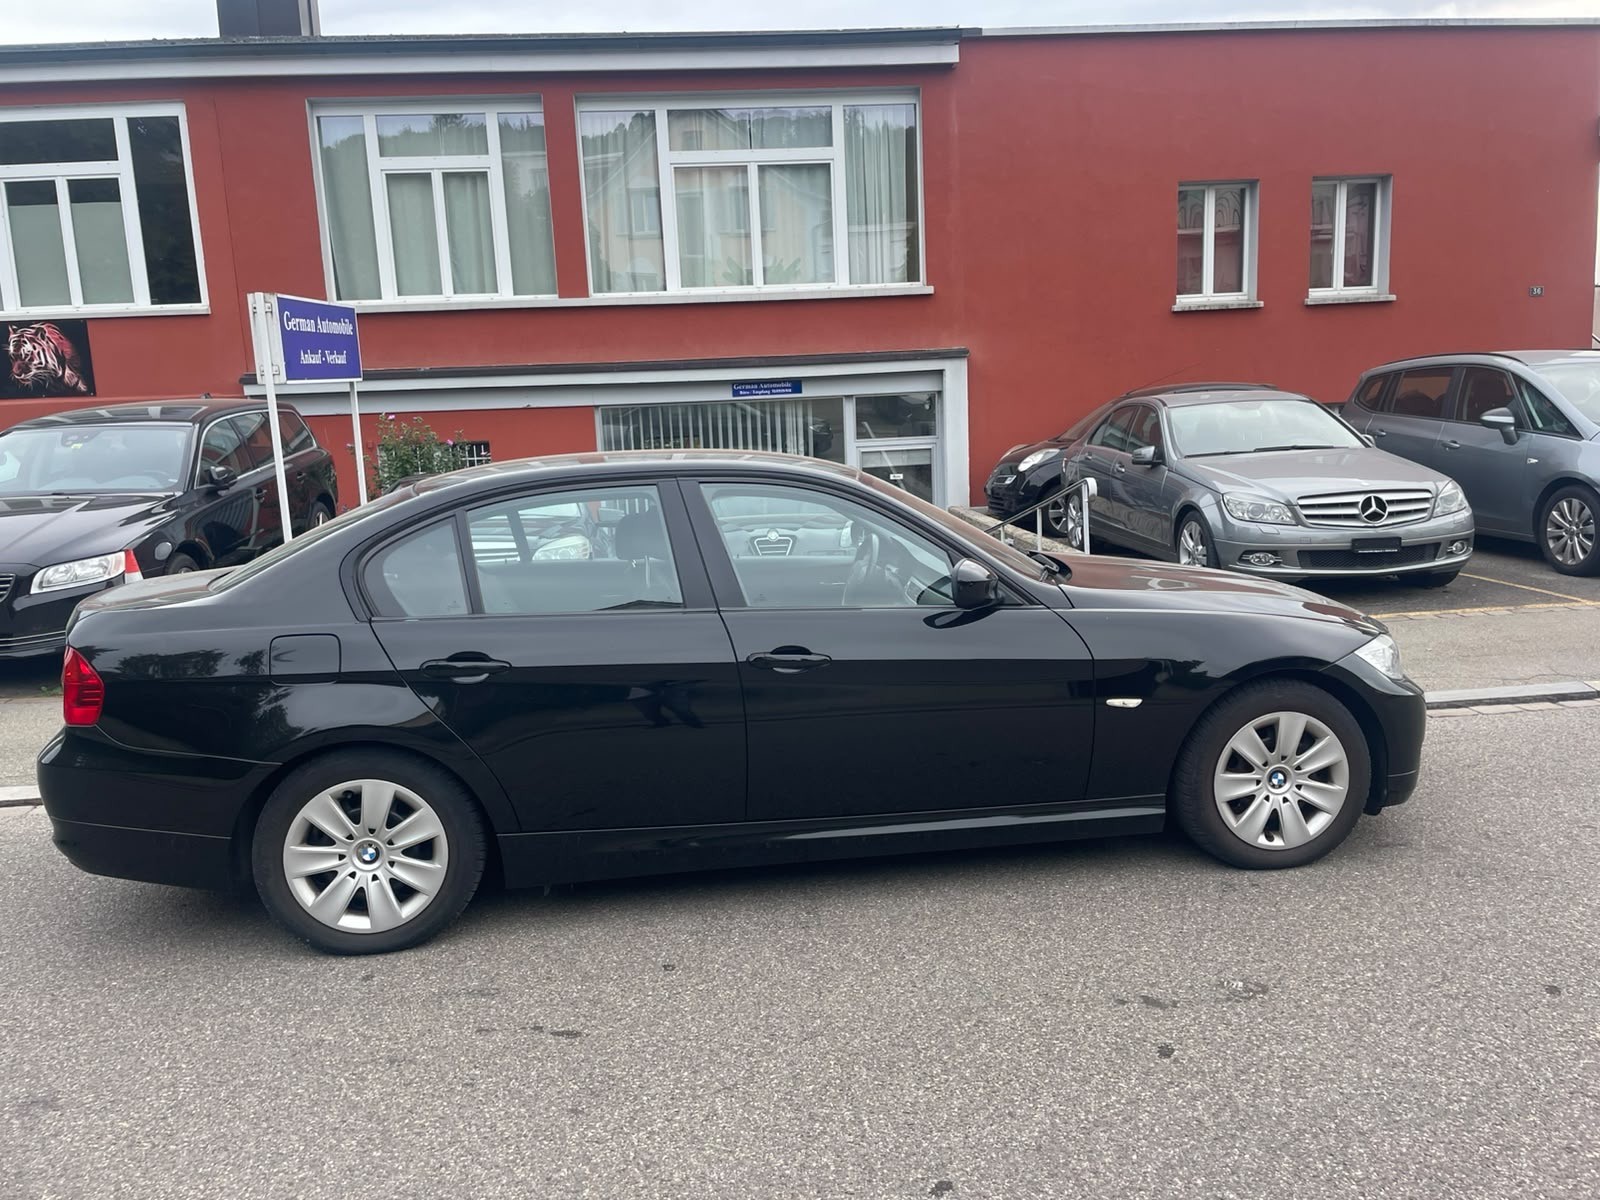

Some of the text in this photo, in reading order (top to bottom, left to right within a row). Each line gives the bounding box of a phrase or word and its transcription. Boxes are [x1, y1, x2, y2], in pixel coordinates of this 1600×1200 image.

[1533, 287, 1541, 295] 36
[283, 311, 353, 335] German Automobile
[300, 349, 322, 364] Ankauf
[325, 350, 347, 364] Verkauf
[759, 381, 792, 389] Automobile
